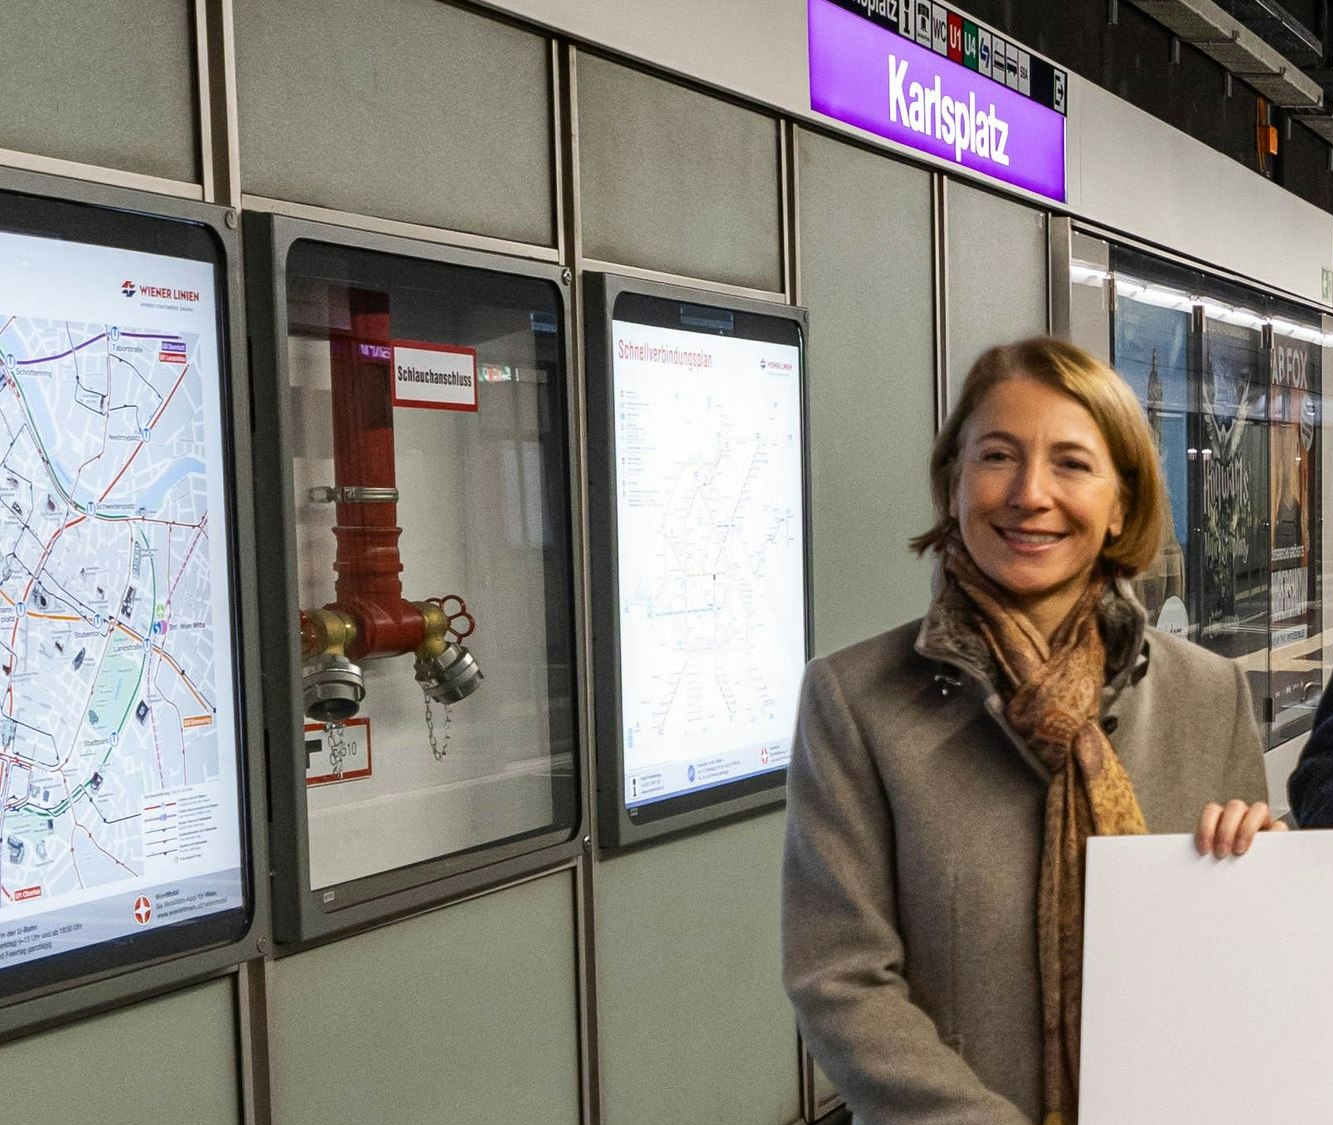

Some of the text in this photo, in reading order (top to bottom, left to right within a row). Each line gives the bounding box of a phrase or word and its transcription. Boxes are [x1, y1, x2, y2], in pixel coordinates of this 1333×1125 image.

[933, 17, 947, 43] WC
[950, 26, 961, 51] U1
[964, 31, 976, 58] U4
[888, 54, 1010, 167] Karlsplatz
[140, 285, 199, 302] WIENER LINIEN
[618, 339, 713, 371] Schnellverbindungsplan
[1287, 347, 1308, 390] FOX
[397, 366, 473, 388] Schlauchanschluss
